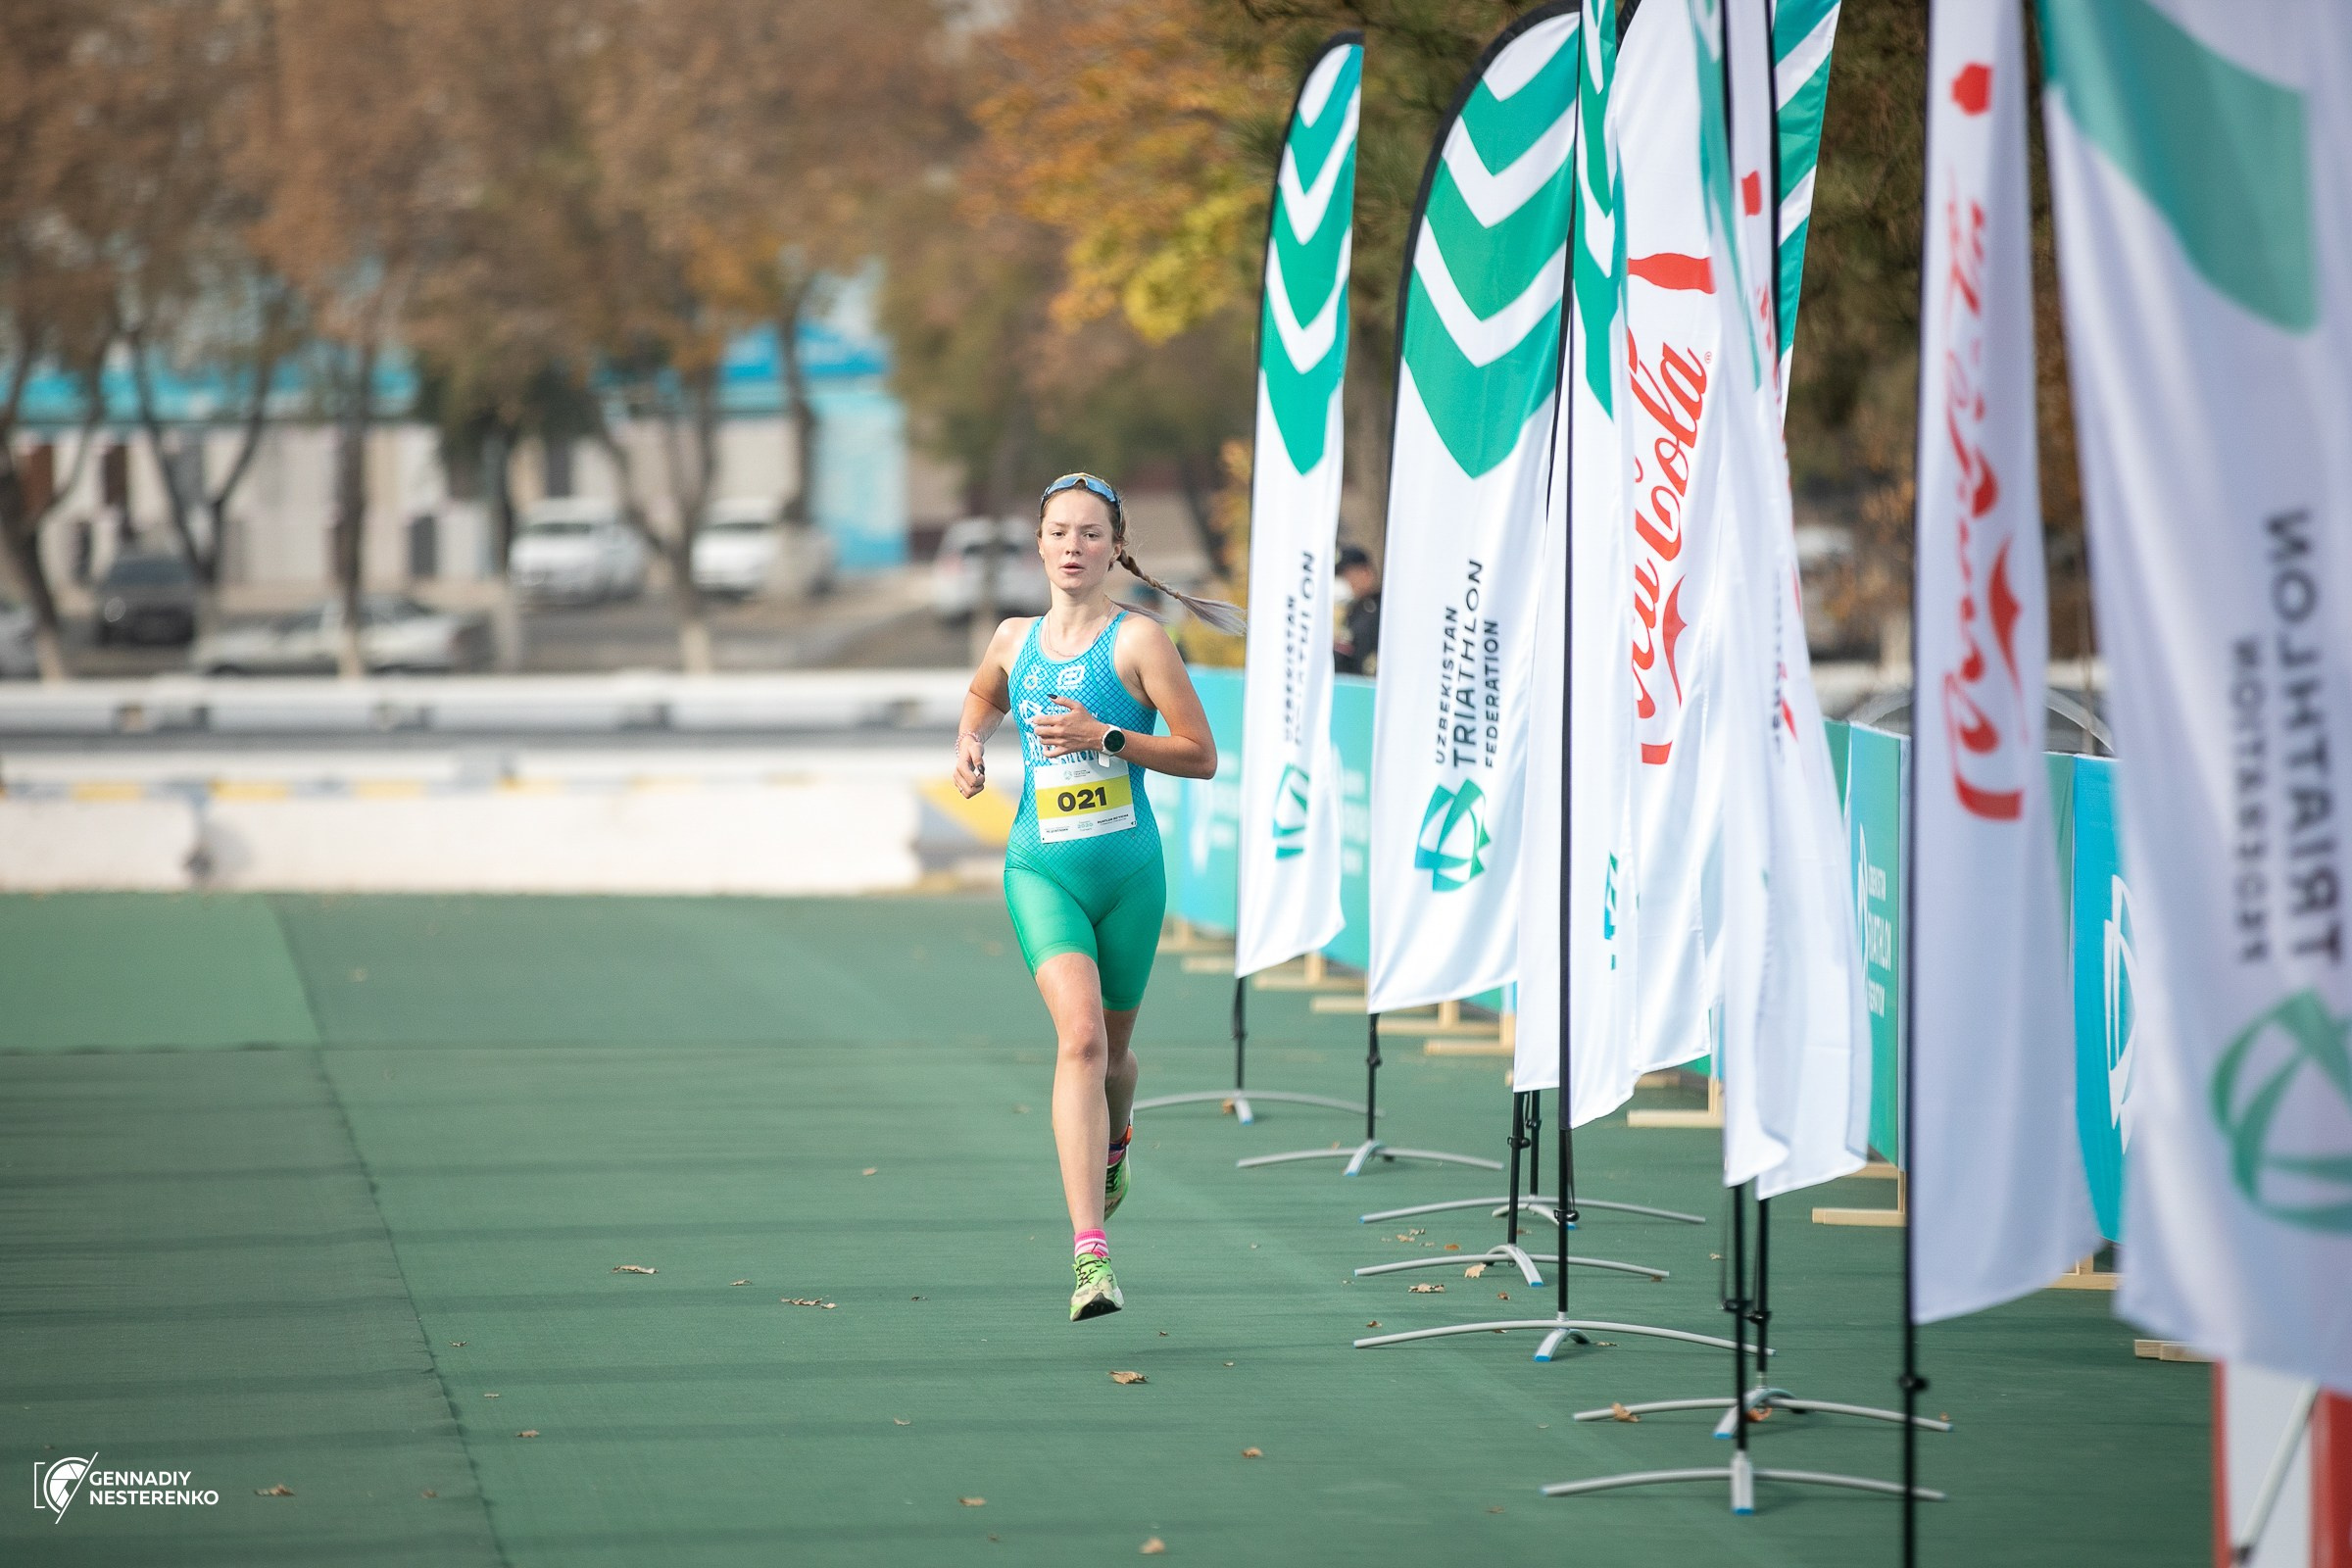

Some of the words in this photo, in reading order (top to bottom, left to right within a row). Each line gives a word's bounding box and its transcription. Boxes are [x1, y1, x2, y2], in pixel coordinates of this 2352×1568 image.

[1628, 331, 1707, 764] caCola
[1436, 607, 1458, 764] UZBEKISTAN
[1453, 559, 1483, 768] TRIATHLON
[1484, 619, 1499, 768] FEDERATION
[1057, 786, 1107, 811] 021
